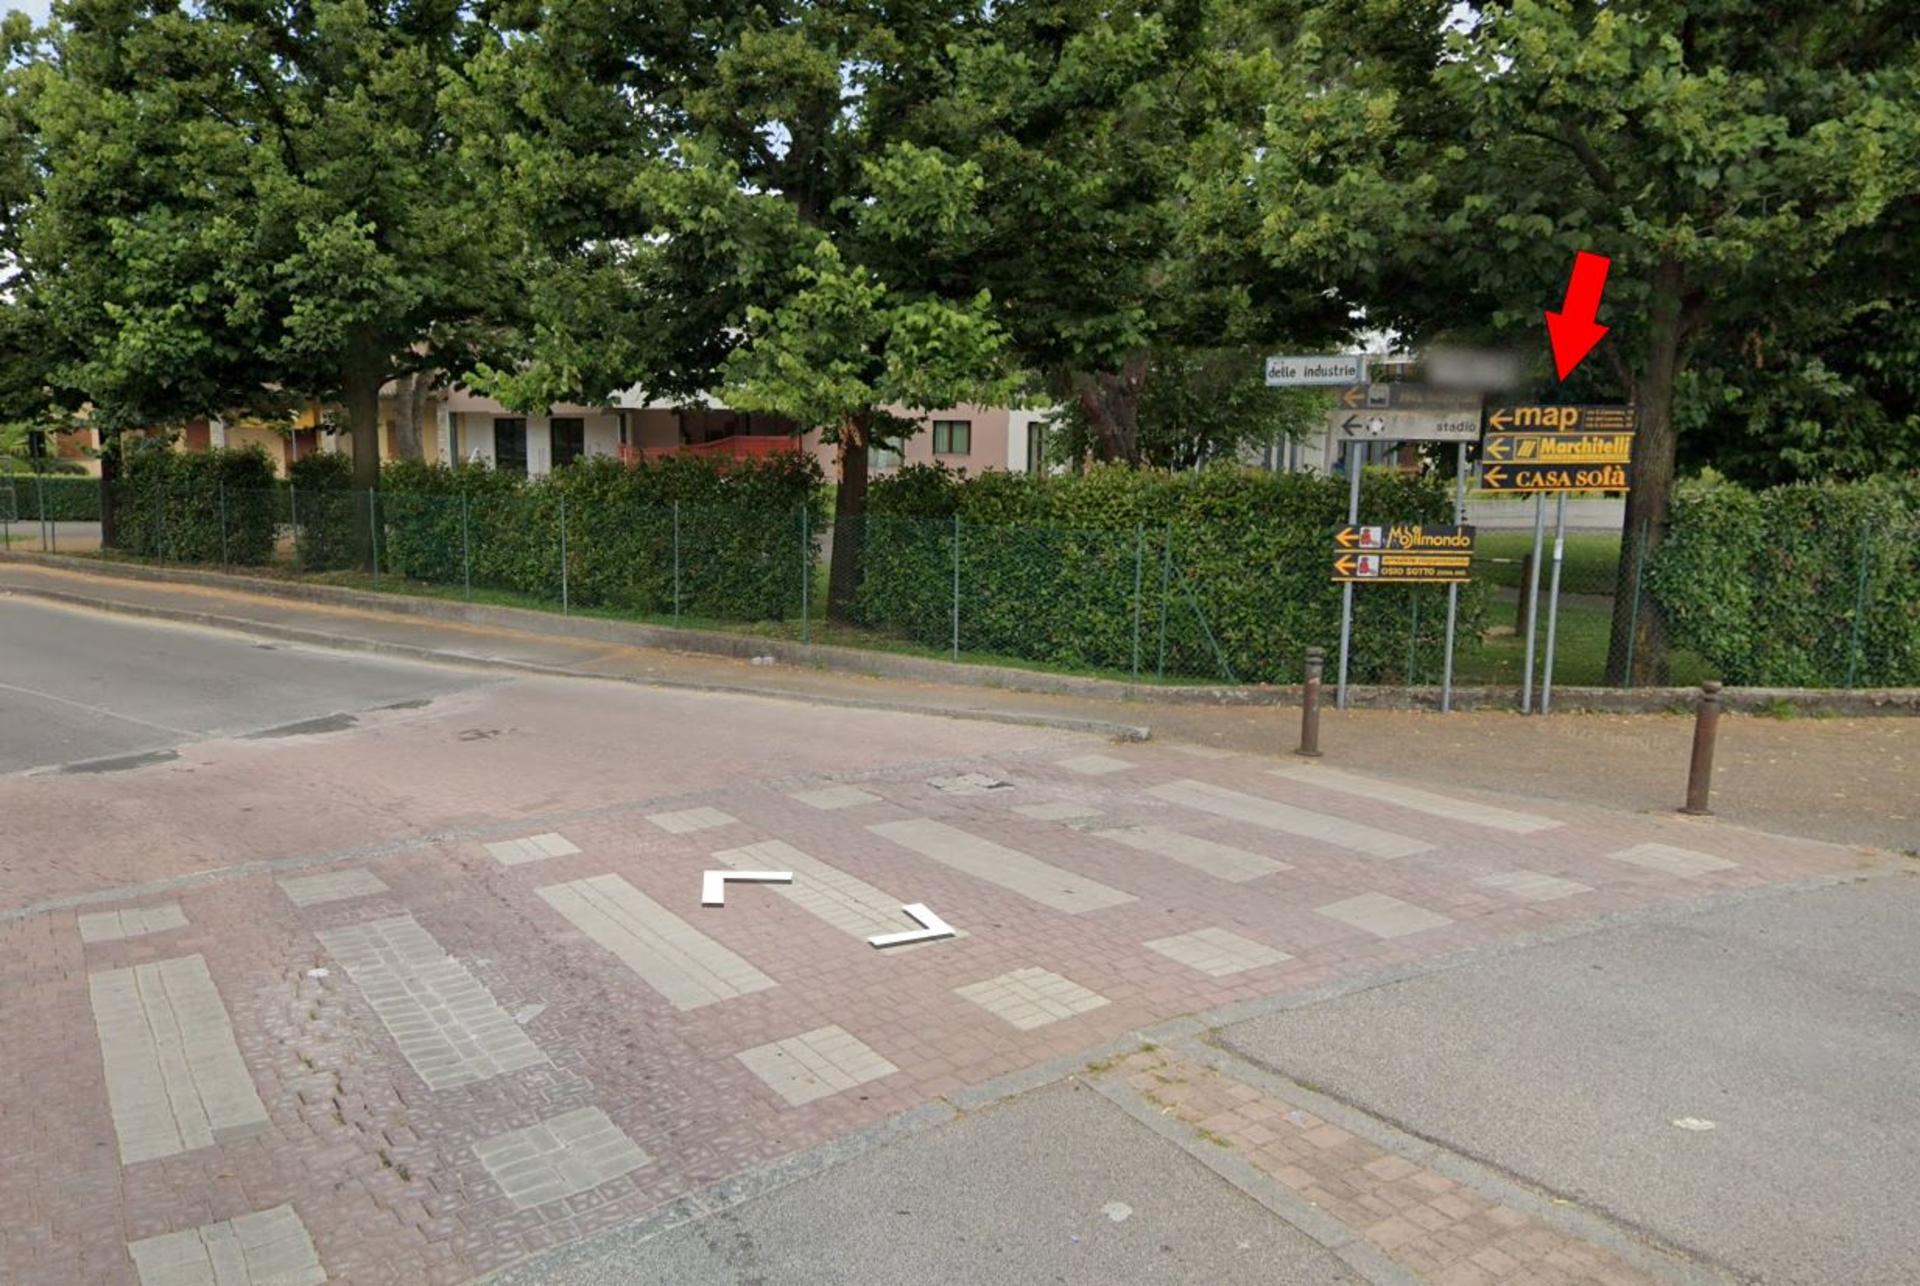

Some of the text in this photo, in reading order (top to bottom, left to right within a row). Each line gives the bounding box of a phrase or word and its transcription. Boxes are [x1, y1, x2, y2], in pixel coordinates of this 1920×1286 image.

[1268, 364, 1357, 378] delle industrie
[1514, 406, 1578, 431] map
[1436, 421, 1477, 433] stadio
[1540, 436, 1630, 455] Marchitelli
[1515, 470, 1572, 487] CASA
[1405, 567, 1436, 576] SOTTO
